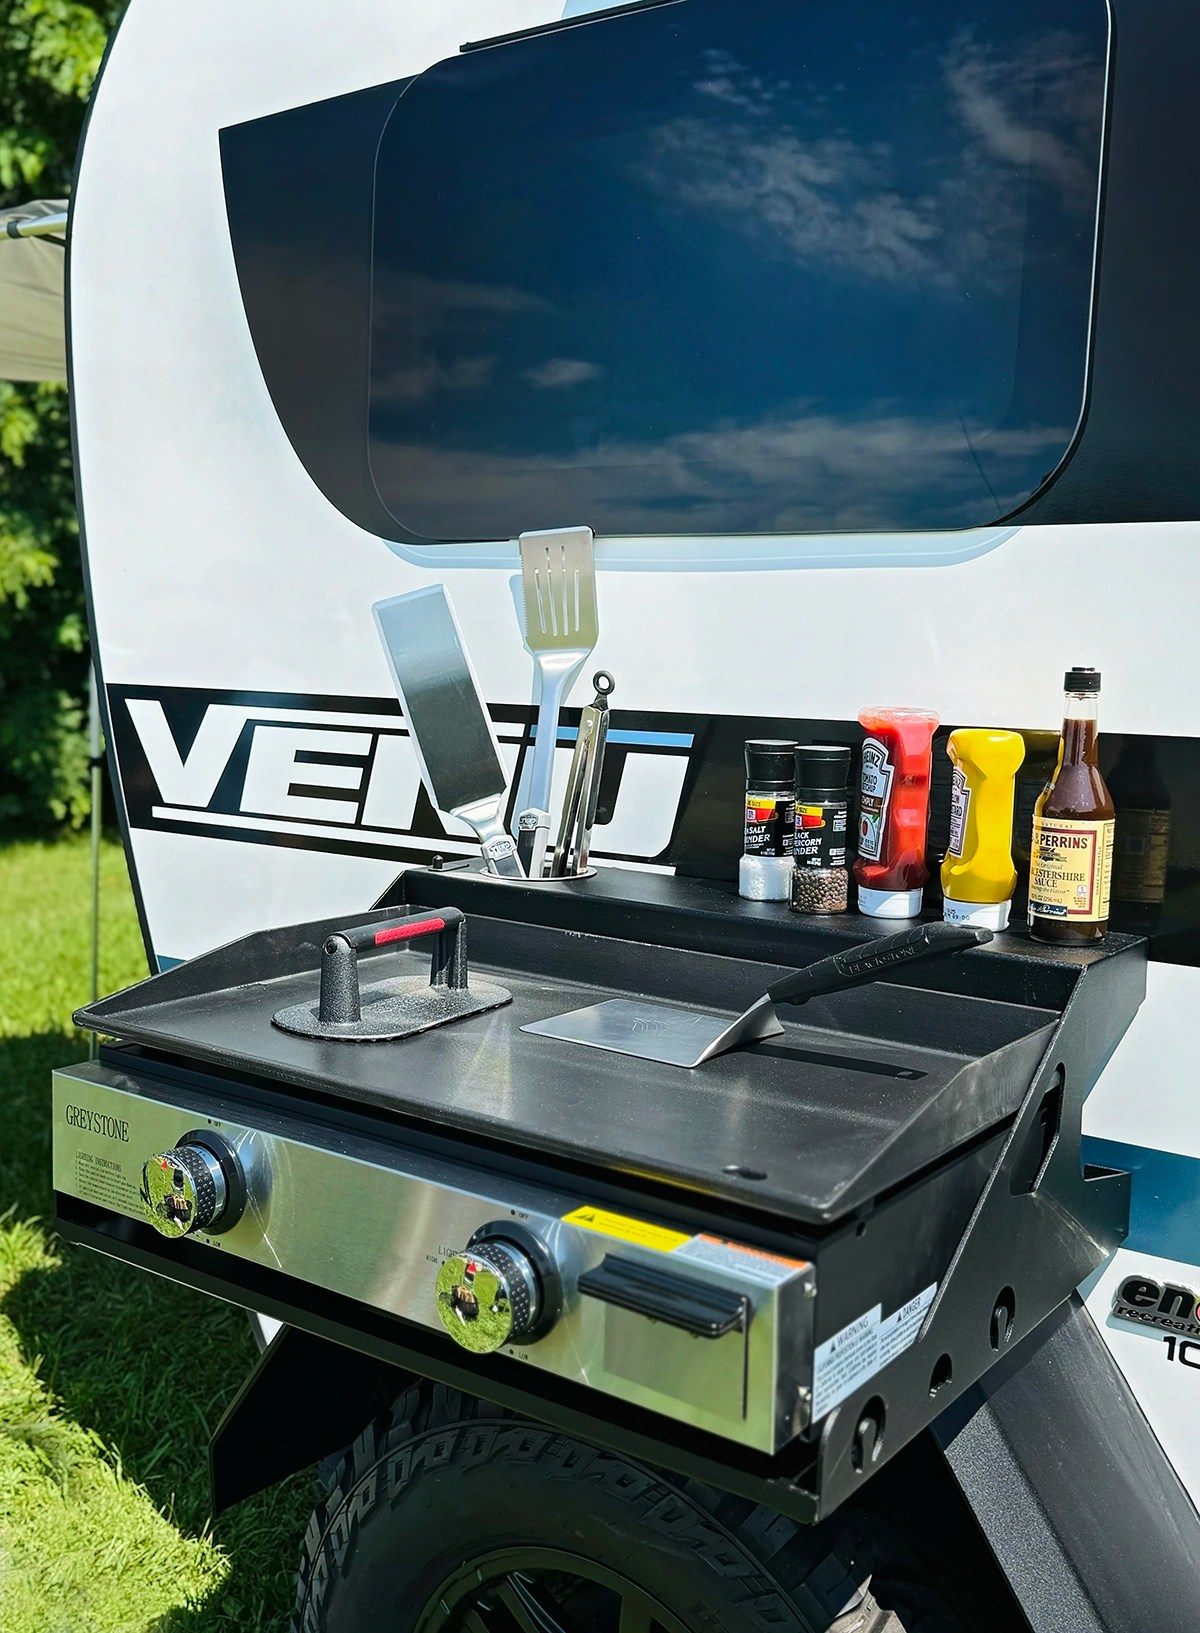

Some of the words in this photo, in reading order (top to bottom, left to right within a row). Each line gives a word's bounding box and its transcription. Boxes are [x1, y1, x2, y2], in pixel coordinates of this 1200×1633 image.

[1040, 834, 1088, 849] PERRINS
[1034, 877, 1058, 888] SAUCE
[66, 1104, 130, 1142] GREYSTONE
[903, 1297, 921, 1319] DANGER
[837, 1316, 869, 1347] WARNING
